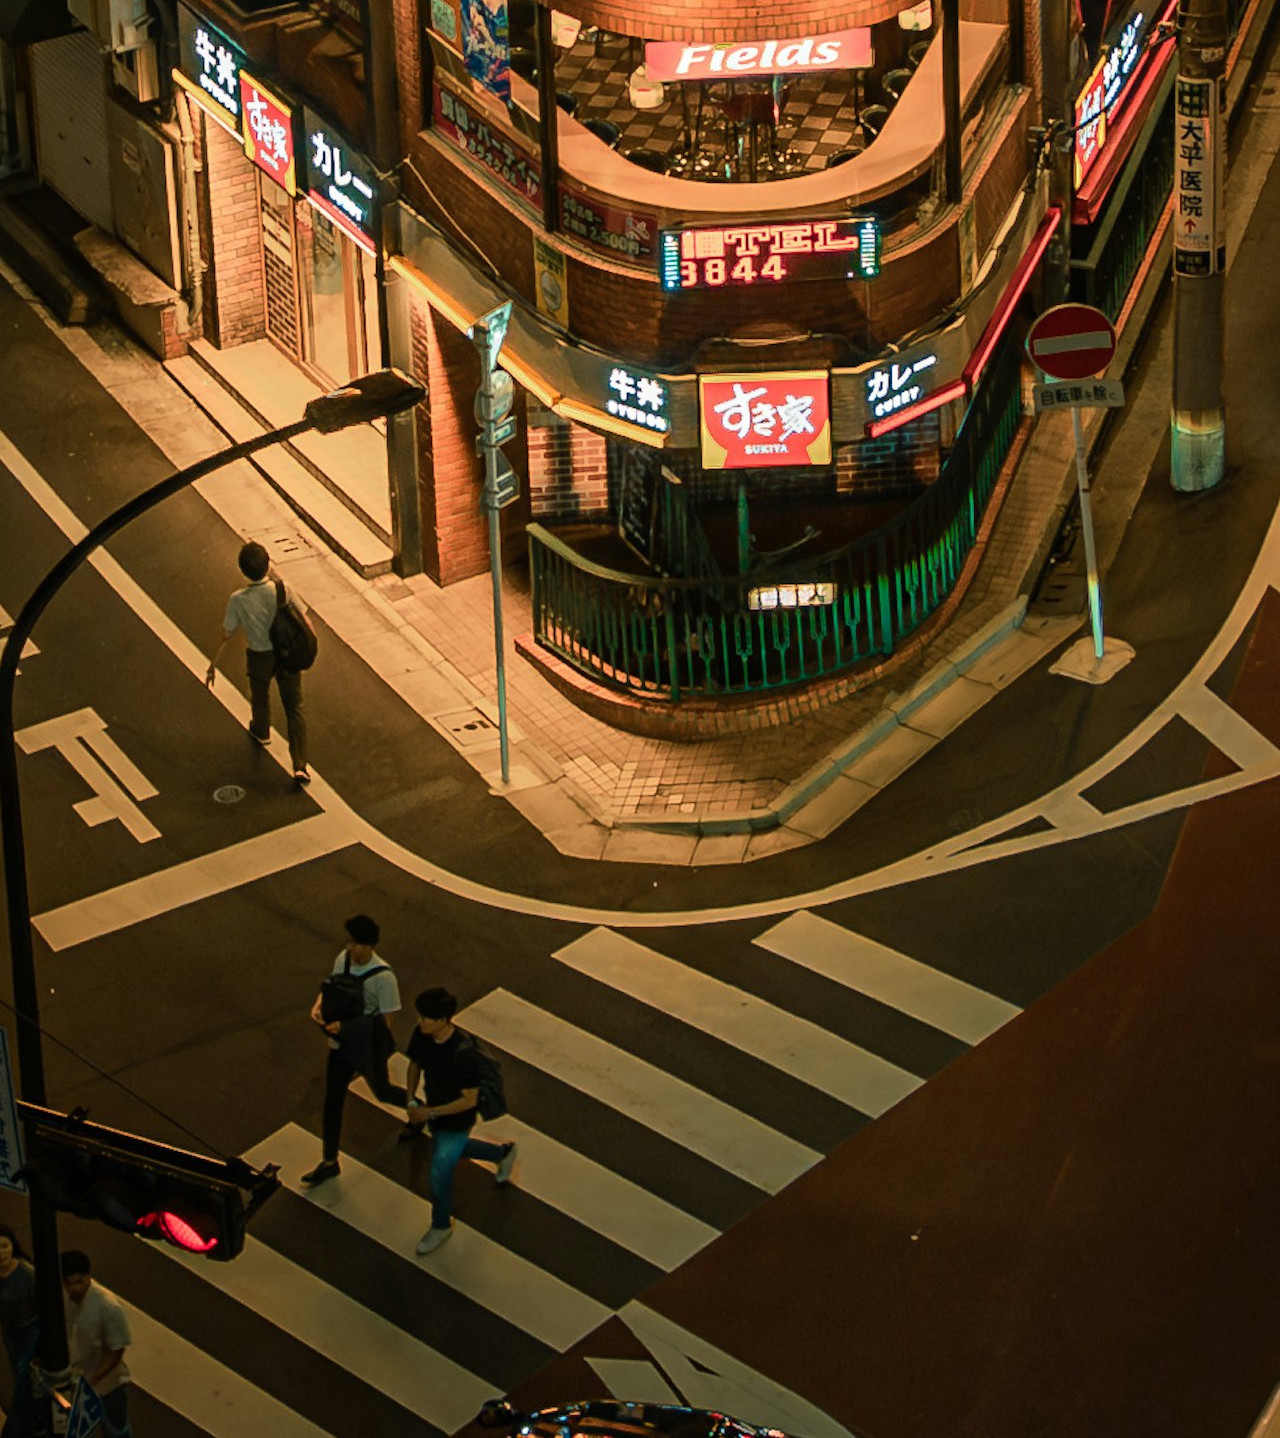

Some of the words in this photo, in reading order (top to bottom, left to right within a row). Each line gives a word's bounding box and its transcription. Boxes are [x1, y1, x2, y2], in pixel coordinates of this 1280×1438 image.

[674, 36, 842, 76] Fields
[309, 130, 374, 201] カレー
[1179, 119, 1204, 218] 大平医院
[724, 222, 860, 257] TEL
[608, 367, 666, 412] 牛丼
[867, 354, 938, 403] カレー
[713, 382, 815, 442] すき家
